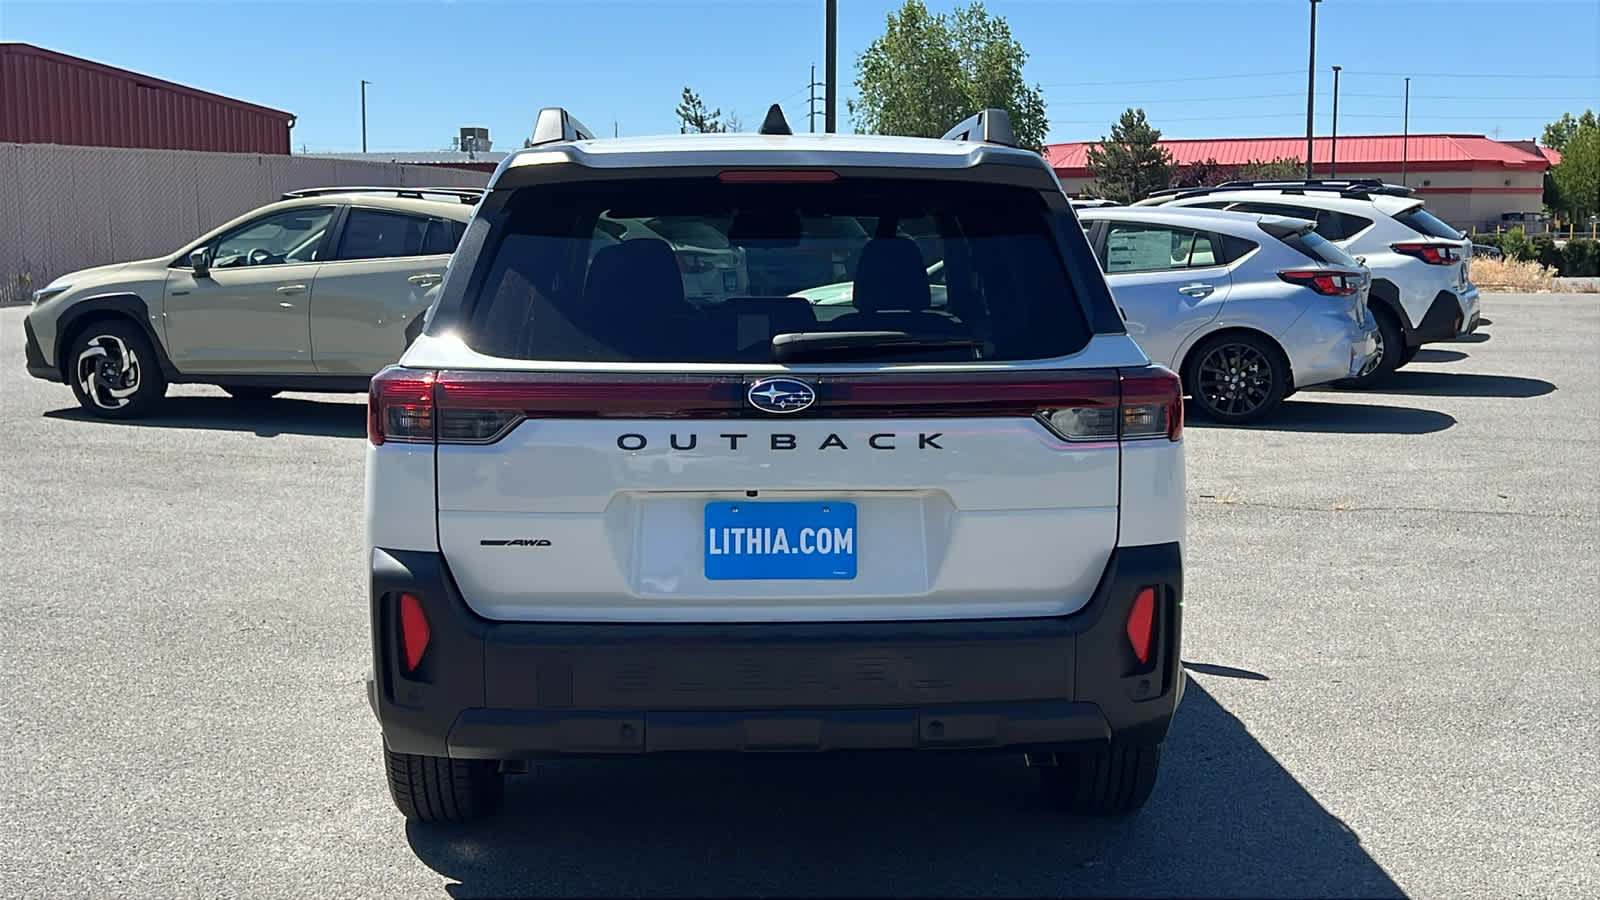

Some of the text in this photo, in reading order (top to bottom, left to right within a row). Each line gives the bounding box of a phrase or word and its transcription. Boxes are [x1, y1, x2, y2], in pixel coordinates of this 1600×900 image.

[616, 432, 944, 451] OUTBACK
[506, 538, 552, 547] AWD
[709, 526, 854, 555] LITHIA.COM
